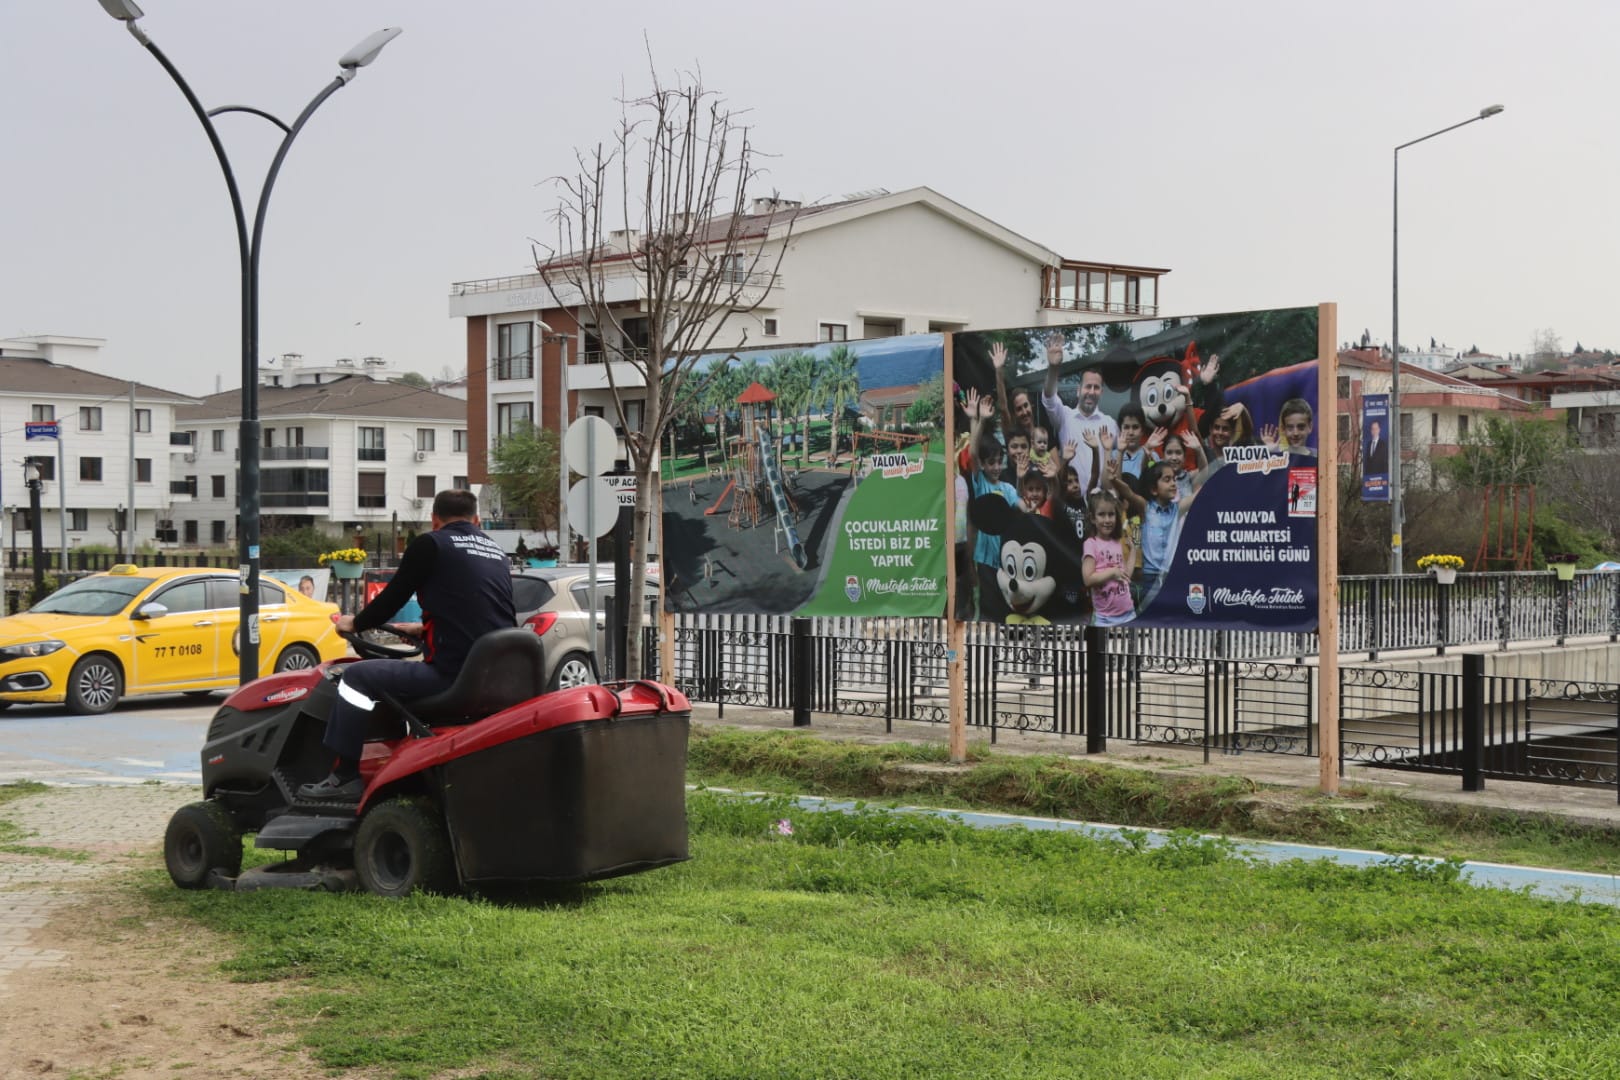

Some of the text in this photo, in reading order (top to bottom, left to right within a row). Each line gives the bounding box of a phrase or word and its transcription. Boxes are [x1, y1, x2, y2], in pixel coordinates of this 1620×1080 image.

[872, 454, 907, 468] YALOVA
[1224, 448, 1270, 462] YALOVA
[1216, 511, 1277, 524] YALOVA'DA
[845, 518, 939, 537] ÇOCUKLARIMIZ
[1207, 526, 1291, 543] HER CUMARTESİ
[850, 535, 932, 551] İSTEDİ BİZ DE
[870, 554, 915, 568] YAPTIK
[1187, 546, 1311, 565] ÇOCUK ETKİNLİĞİ GÜNÜ
[866, 577, 909, 595] Mustafa
[1213, 587, 1305, 607] Mustafa Tutuk
[154, 644, 202, 658] 77 T 0108
